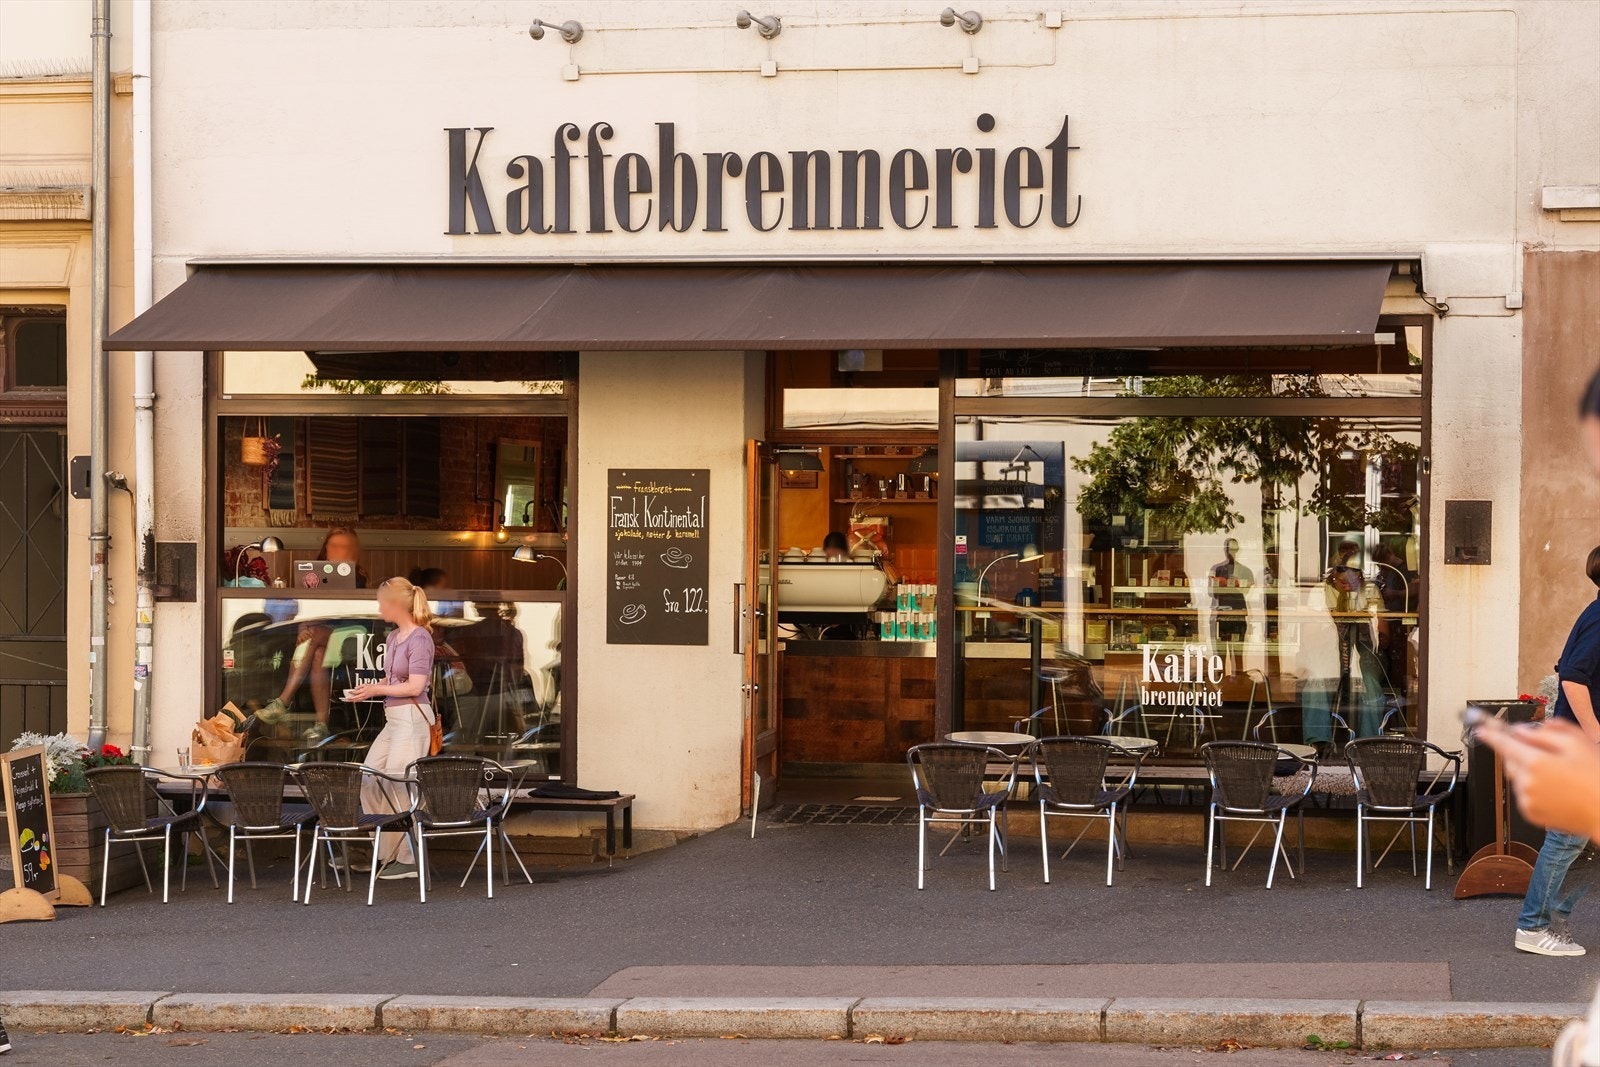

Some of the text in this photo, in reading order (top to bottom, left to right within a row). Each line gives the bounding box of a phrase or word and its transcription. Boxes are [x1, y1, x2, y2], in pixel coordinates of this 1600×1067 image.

[443, 113, 1082, 236] Kaffebrenneriet
[610, 495, 706, 528] Fransk Kontinental
[1140, 643, 1223, 684] Kaffe
[1141, 685, 1223, 707] brenneriet
